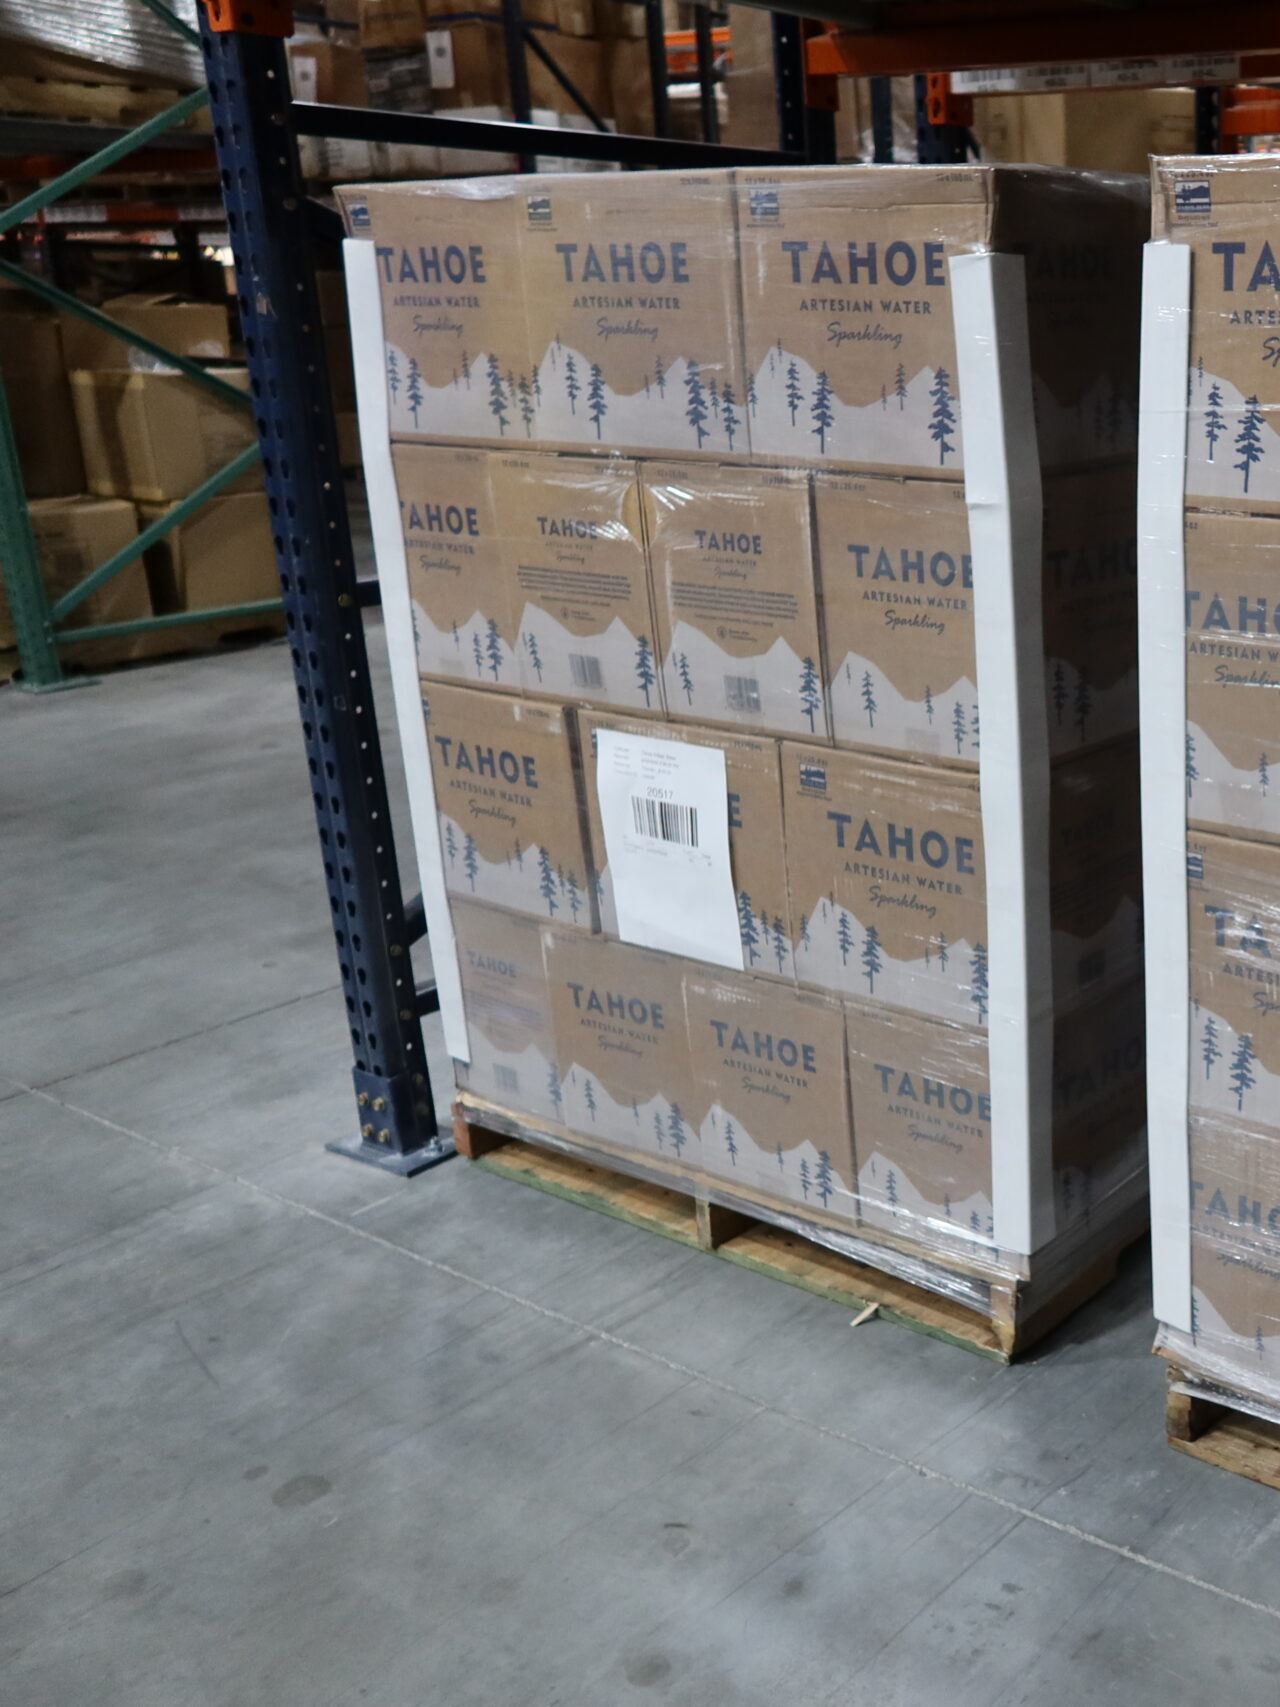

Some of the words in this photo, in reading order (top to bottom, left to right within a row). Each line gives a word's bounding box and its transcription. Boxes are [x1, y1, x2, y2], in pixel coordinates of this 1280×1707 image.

[376, 246, 486, 284] TAHOE
[556, 242, 690, 283] TAHOE
[782, 240, 945, 286] TAHOE
[573, 296, 633, 309] ARTESIAN
[638, 297, 681, 310] WATER
[800, 298, 873, 313] ARTESIAN
[880, 300, 932, 315] WATER
[597, 317, 659, 340] Sparkling
[826, 322, 903, 348] Sparkling
[537, 517, 599, 540] TAHOE
[694, 530, 762, 555] TAHOE
[848, 544, 973, 588] TAHOE
[862, 590, 921, 606] ARTESIAN
[927, 596, 967, 611] WATER
[884, 610, 945, 635] Sparkling
[1188, 643, 1261, 663] ARTESIAN
[435, 735, 539, 789] TAHOE
[499, 789, 532, 808] WATER
[646, 787, 674, 799] 20517
[827, 810, 974, 876] TAHOE
[844, 861, 911, 885] ARTESIAN
[916, 876, 962, 895] WATER
[868, 885, 936, 918] Sparkling
[467, 951, 517, 978] TAHOE
[567, 982, 665, 1029] TAHOE
[710, 1020, 817, 1073] TAHOE
[775, 1071, 808, 1088] WATER
[874, 1063, 991, 1121] TAHOE
[945, 1117, 983, 1139] WATER
